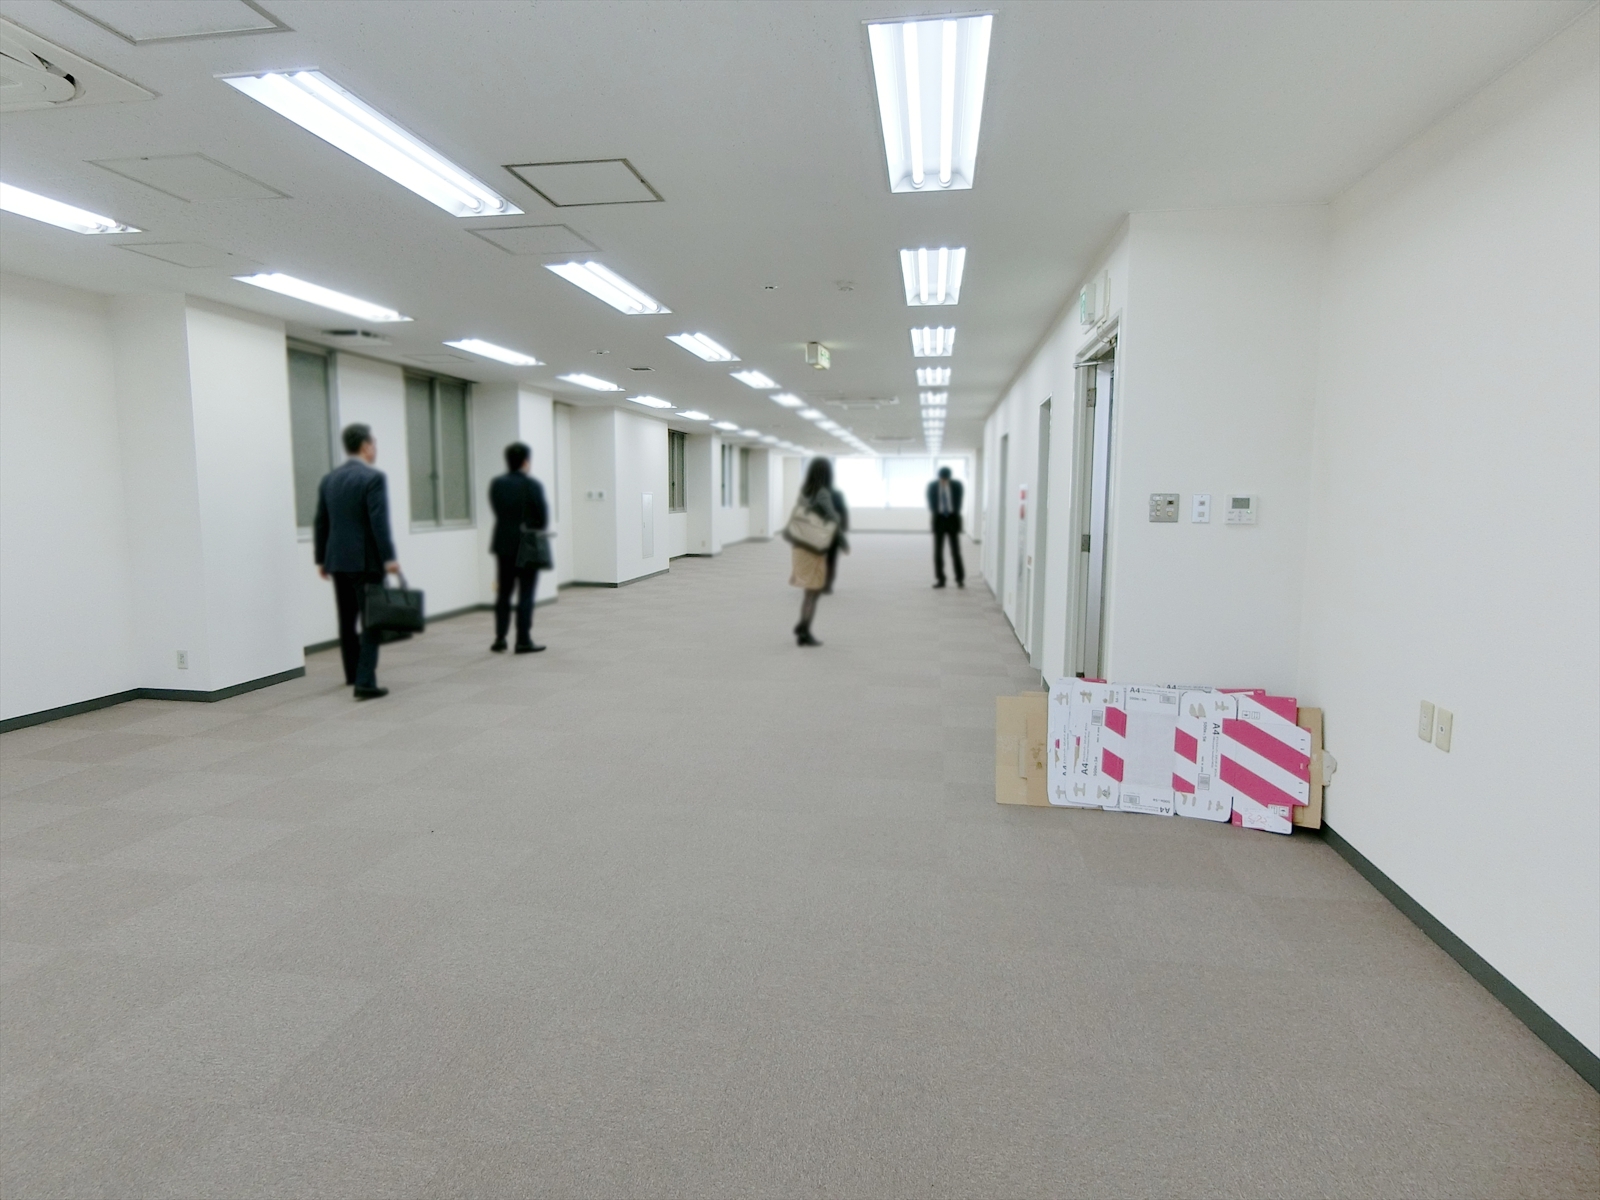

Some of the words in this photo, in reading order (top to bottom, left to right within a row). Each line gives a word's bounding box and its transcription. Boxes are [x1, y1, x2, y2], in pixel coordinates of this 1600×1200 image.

[1212, 722, 1220, 735] A4
[1081, 762, 1089, 775] A4
[1159, 806, 1171, 814] A4
